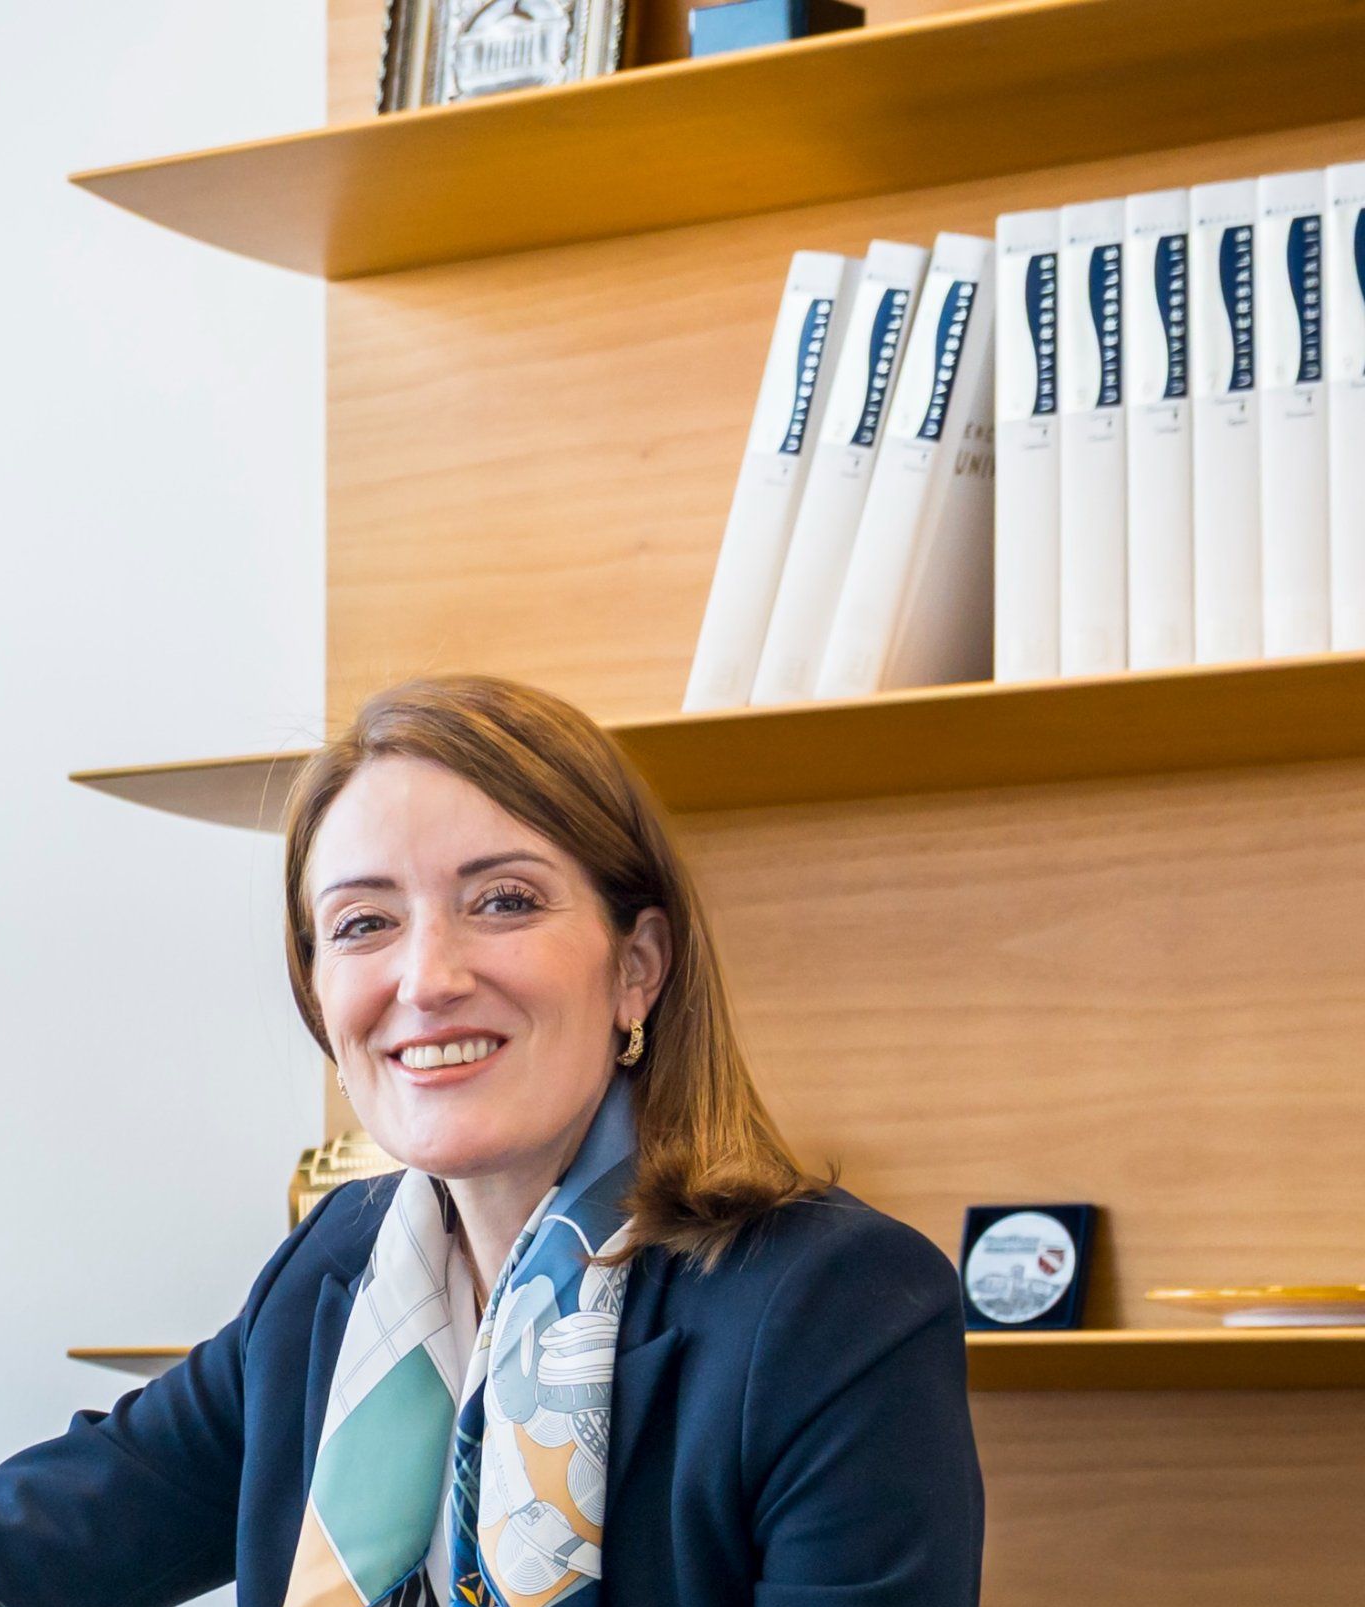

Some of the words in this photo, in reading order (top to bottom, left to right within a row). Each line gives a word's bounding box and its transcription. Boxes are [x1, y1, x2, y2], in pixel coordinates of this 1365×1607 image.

[785, 300, 831, 452] UNIVERSALIS
[859, 290, 909, 444] UNIVERSALIS
[924, 281, 974, 437] UNIVERSALIS
[1038, 254, 1056, 413] UNIVERSALIS
[1102, 245, 1120, 405] UNIVERSALIS
[1168, 235, 1186, 396] UNIVERSALIS
[1234, 226, 1252, 389] UNIVERSALIS
[1302, 217, 1320, 380] UNIVERSALIS
